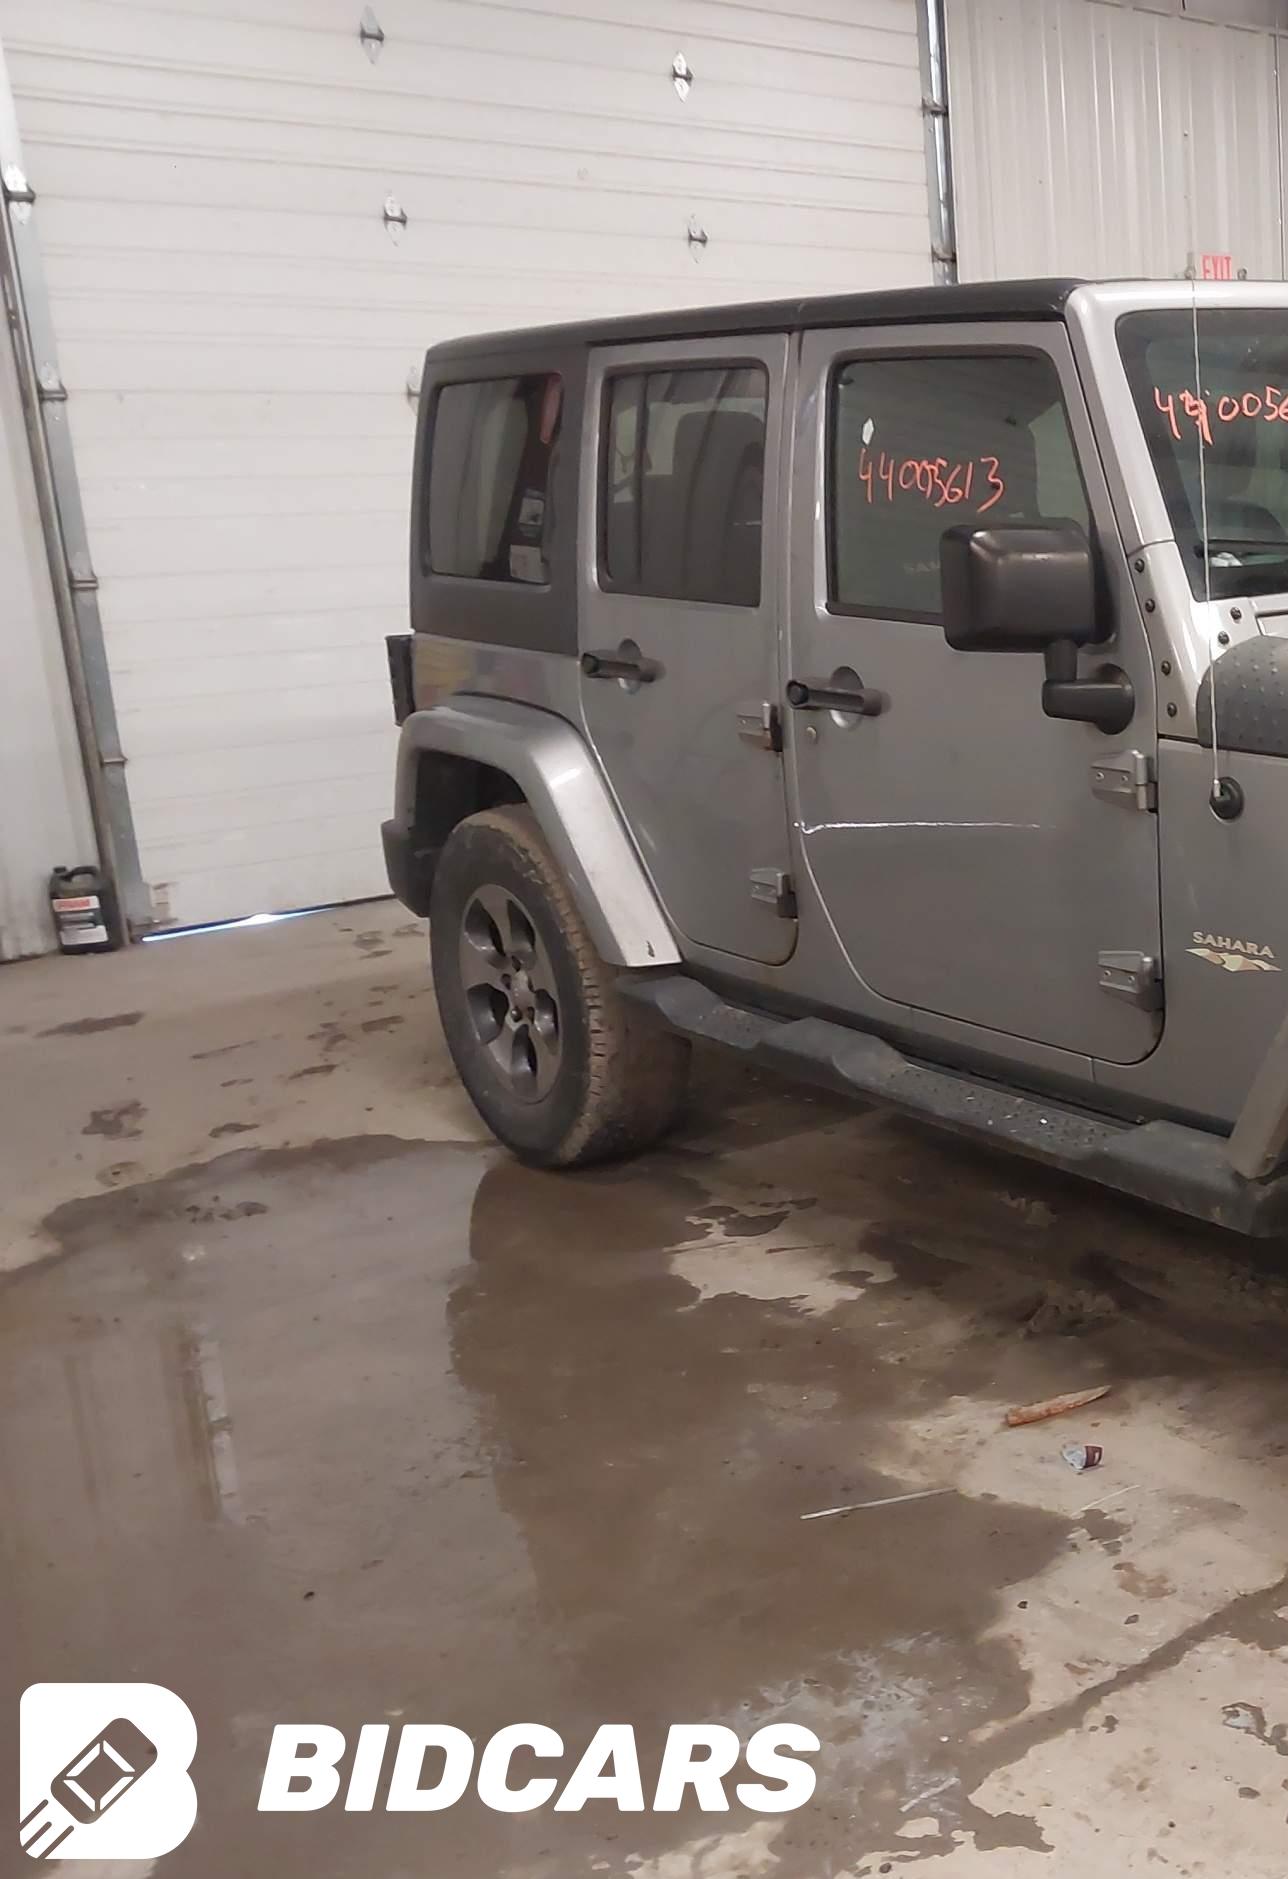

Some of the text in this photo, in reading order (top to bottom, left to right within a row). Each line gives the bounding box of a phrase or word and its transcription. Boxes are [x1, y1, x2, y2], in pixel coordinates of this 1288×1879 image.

[1202, 255, 1233, 280] EXIT
[857, 447, 1005, 513] 44005613
[1192, 931, 1275, 959] SAHARA
